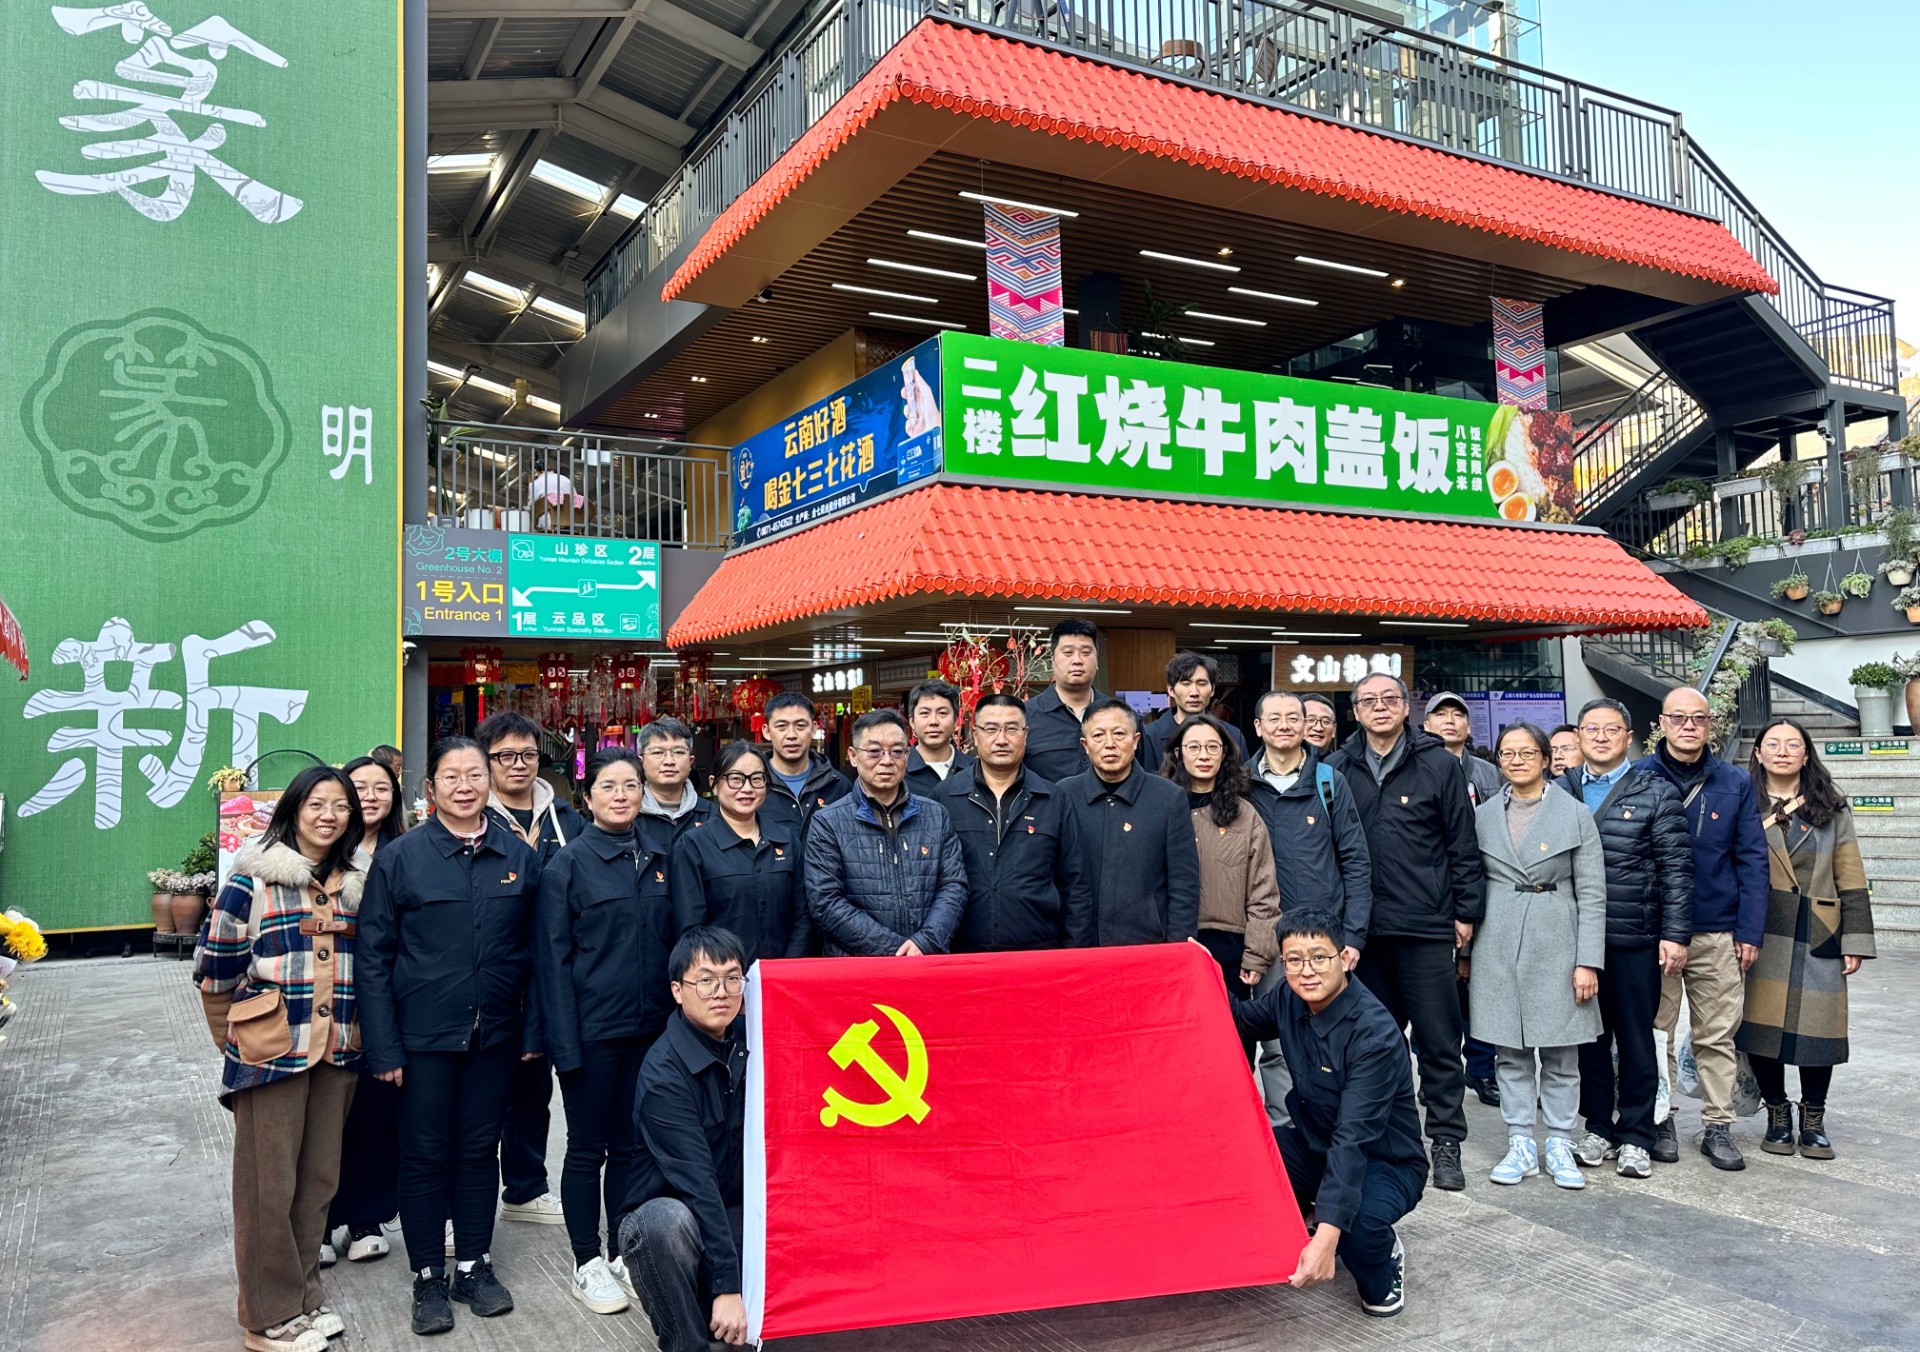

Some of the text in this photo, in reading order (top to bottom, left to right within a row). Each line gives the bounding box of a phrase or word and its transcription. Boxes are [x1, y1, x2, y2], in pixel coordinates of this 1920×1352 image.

[961, 356, 1003, 456] 二楼
[784, 396, 846, 459] 云南好酒
[1009, 364, 1456, 495] 红烧牛肉盖饭
[321, 404, 373, 485] 明
[764, 433, 874, 511] 喝金七三七花酒
[444, 546, 503, 563] 2号大棚
[555, 541, 608, 557] 山珍区
[628, 545, 655, 566] 2层
[416, 561, 503, 575] Greenhouse No. 2
[416, 580, 503, 605] 1号入口
[424, 606, 502, 622] Entrance 1
[511, 611, 537, 632] 1层
[552, 612, 605, 626] 云品区
[17, 617, 309, 829] 新
